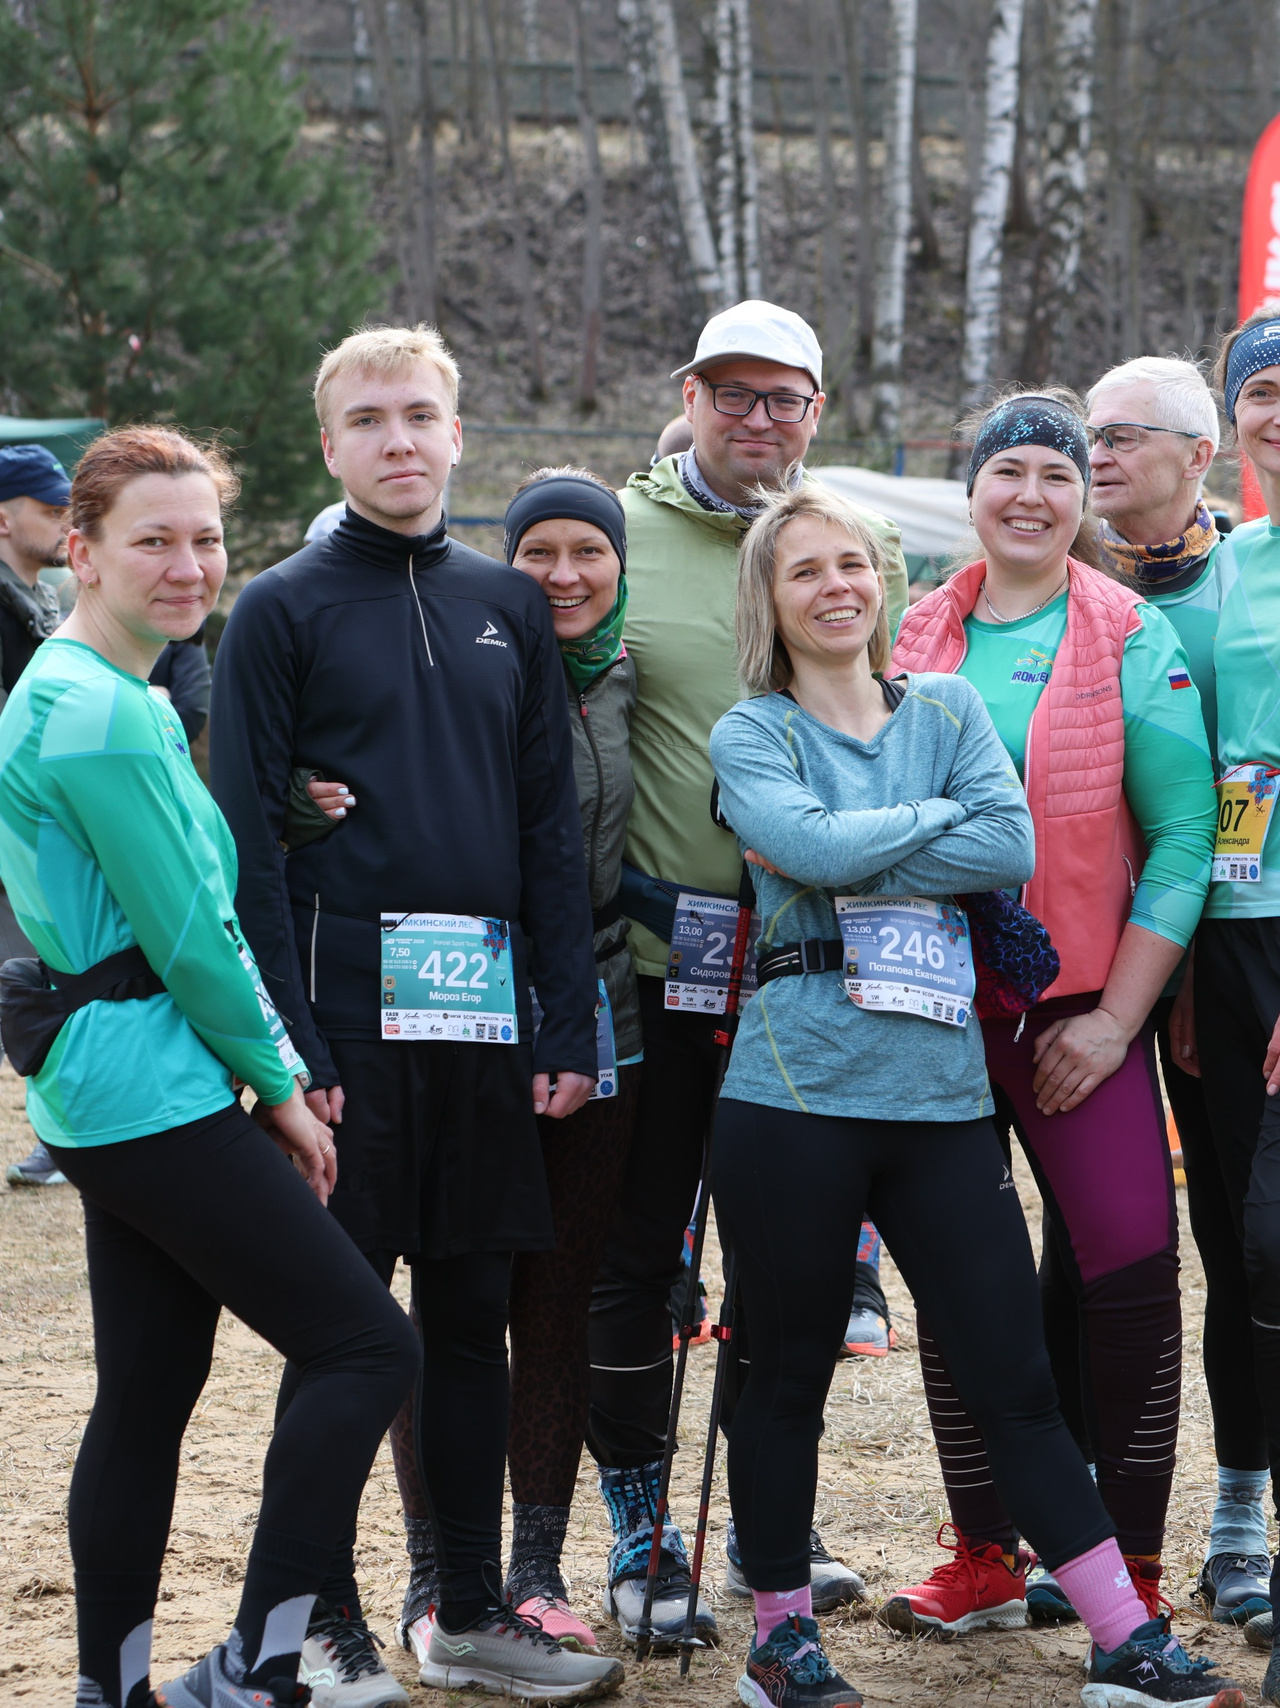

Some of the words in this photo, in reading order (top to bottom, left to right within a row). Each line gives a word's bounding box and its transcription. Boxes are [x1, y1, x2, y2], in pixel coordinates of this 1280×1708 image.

[475, 637, 508, 648] DEMIX
[1011, 670, 1050, 685] IRONZEL
[687, 899, 740, 913] ХИМКИНСКИ
[846, 899, 912, 909] ХИМКИНСКИЙ
[912, 901, 928, 911] ЛЕС
[457, 920, 473, 929] ЛЕС
[678, 925, 703, 936] 13,00
[846, 925, 872, 934] 13,00
[390, 947, 411, 958] 7,50
[879, 926, 945, 969] 246
[418, 950, 488, 989] 422
[690, 966, 731, 979] Сидоров
[869, 962, 914, 976] Потапова
[915, 968, 957, 986] Екатерина
[429, 991, 460, 1003] Мороз
[461, 992, 482, 1004] Егор
